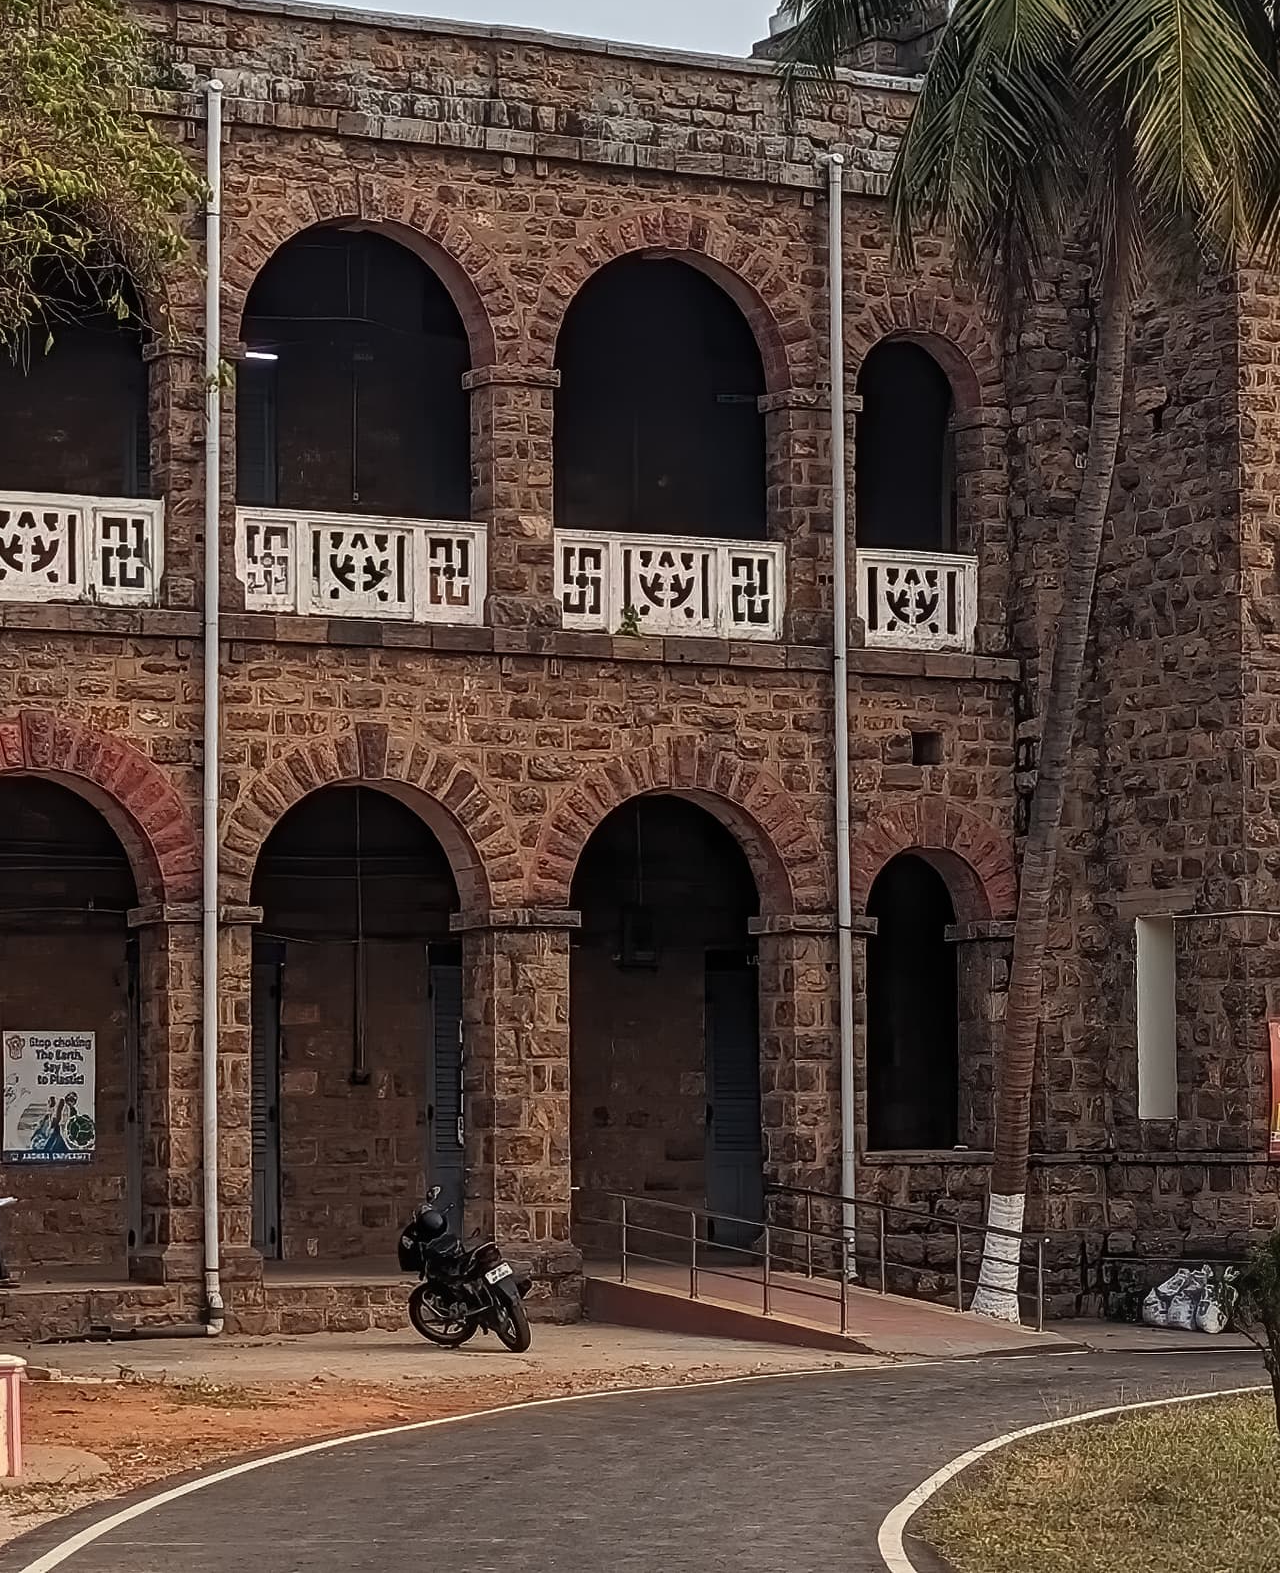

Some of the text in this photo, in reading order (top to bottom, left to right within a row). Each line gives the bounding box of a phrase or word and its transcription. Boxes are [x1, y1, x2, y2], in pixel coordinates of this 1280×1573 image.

[53, 1036, 91, 1050] choking
[36, 1049, 54, 1060] The
[44, 1062, 77, 1075] Say No
